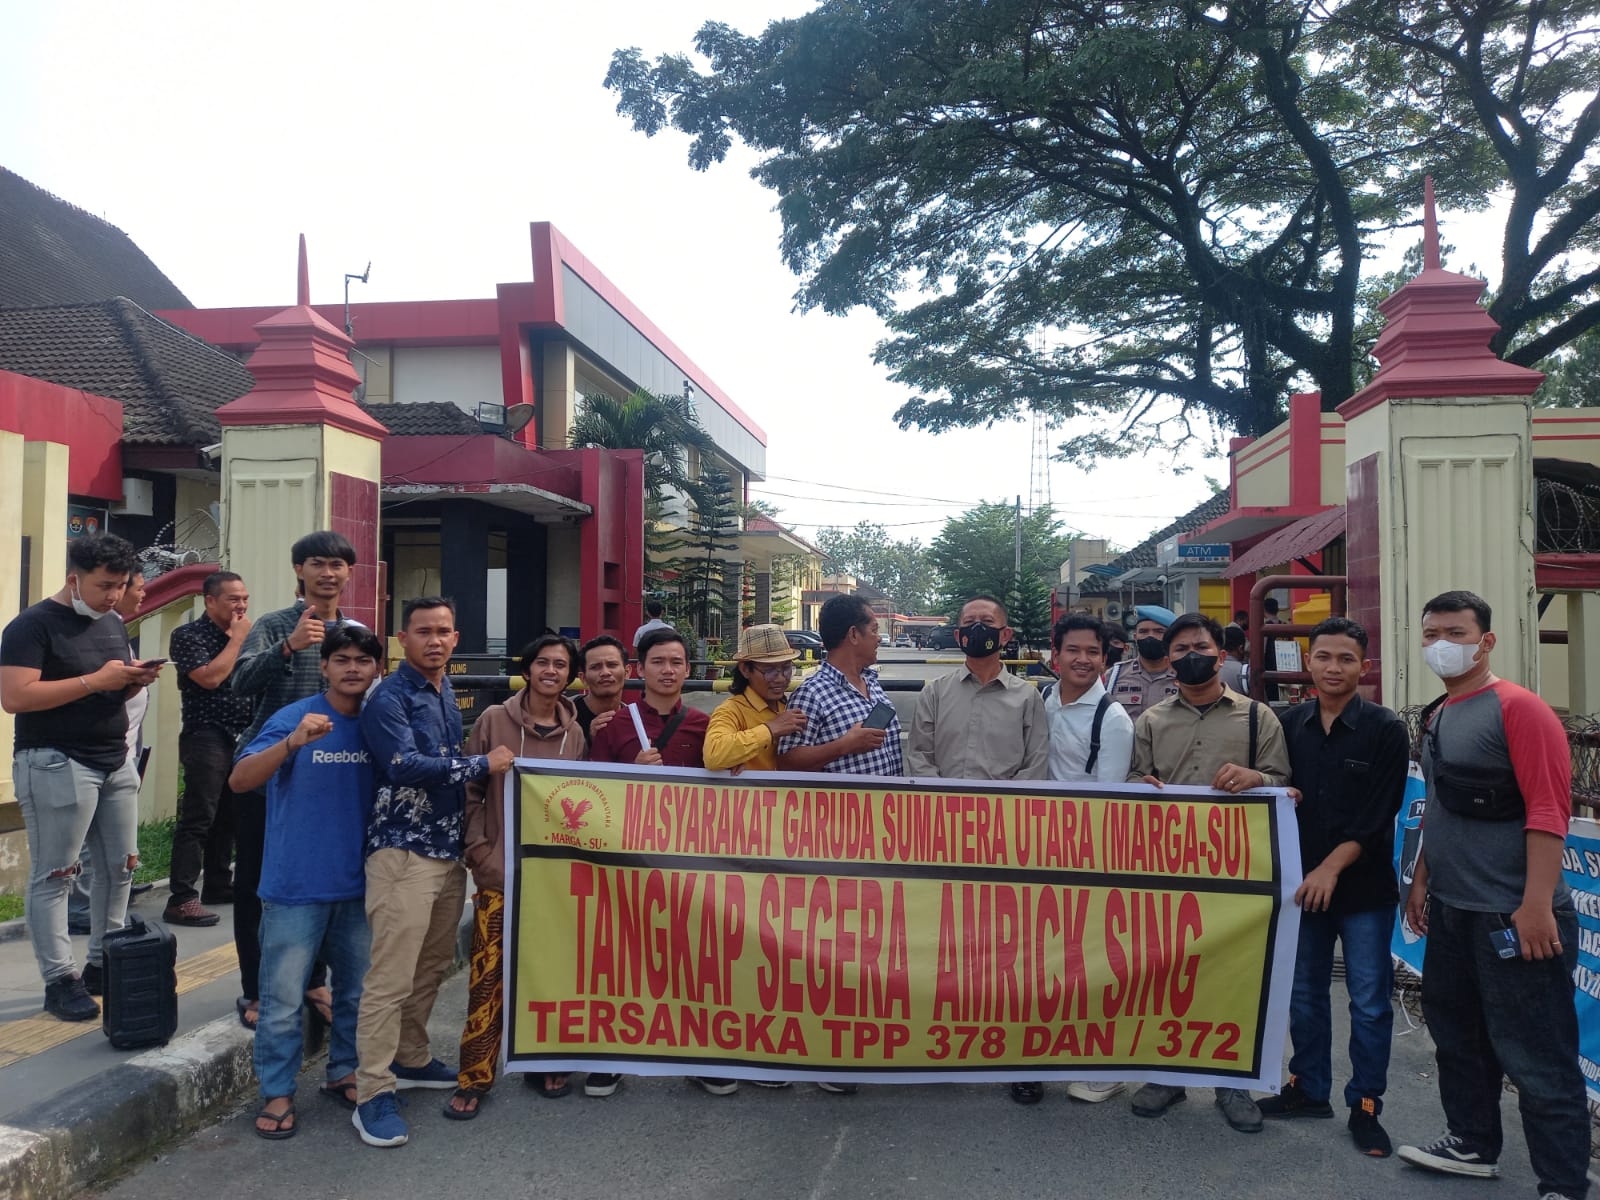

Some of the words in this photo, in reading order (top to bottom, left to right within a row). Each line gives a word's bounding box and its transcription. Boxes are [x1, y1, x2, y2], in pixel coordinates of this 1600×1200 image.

[1187, 546, 1212, 556] ATM
[312, 749, 369, 764] Reebok
[551, 832, 582, 848] MARGA
[589, 837, 603, 850] SU
[621, 783, 776, 856] MASYARAKAT
[782, 790, 876, 860] GARUDA
[882, 793, 1008, 866] SUMATERA
[1015, 798, 1095, 869] UTARA
[1102, 801, 1250, 880] (MARGA-SU)
[570, 862, 746, 1006] TANGKAP
[757, 873, 911, 1020] SEGERA
[933, 882, 1091, 1023] AMRICK
[1102, 888, 1203, 1019] SING
[528, 1000, 808, 1057] TERSANGKA
[822, 1019, 910, 1060] TPP
[925, 1024, 1006, 1060] 378
[1022, 1021, 1116, 1057] DAN
[1129, 1019, 1145, 1057] /
[1157, 1020, 1241, 1061] 372
